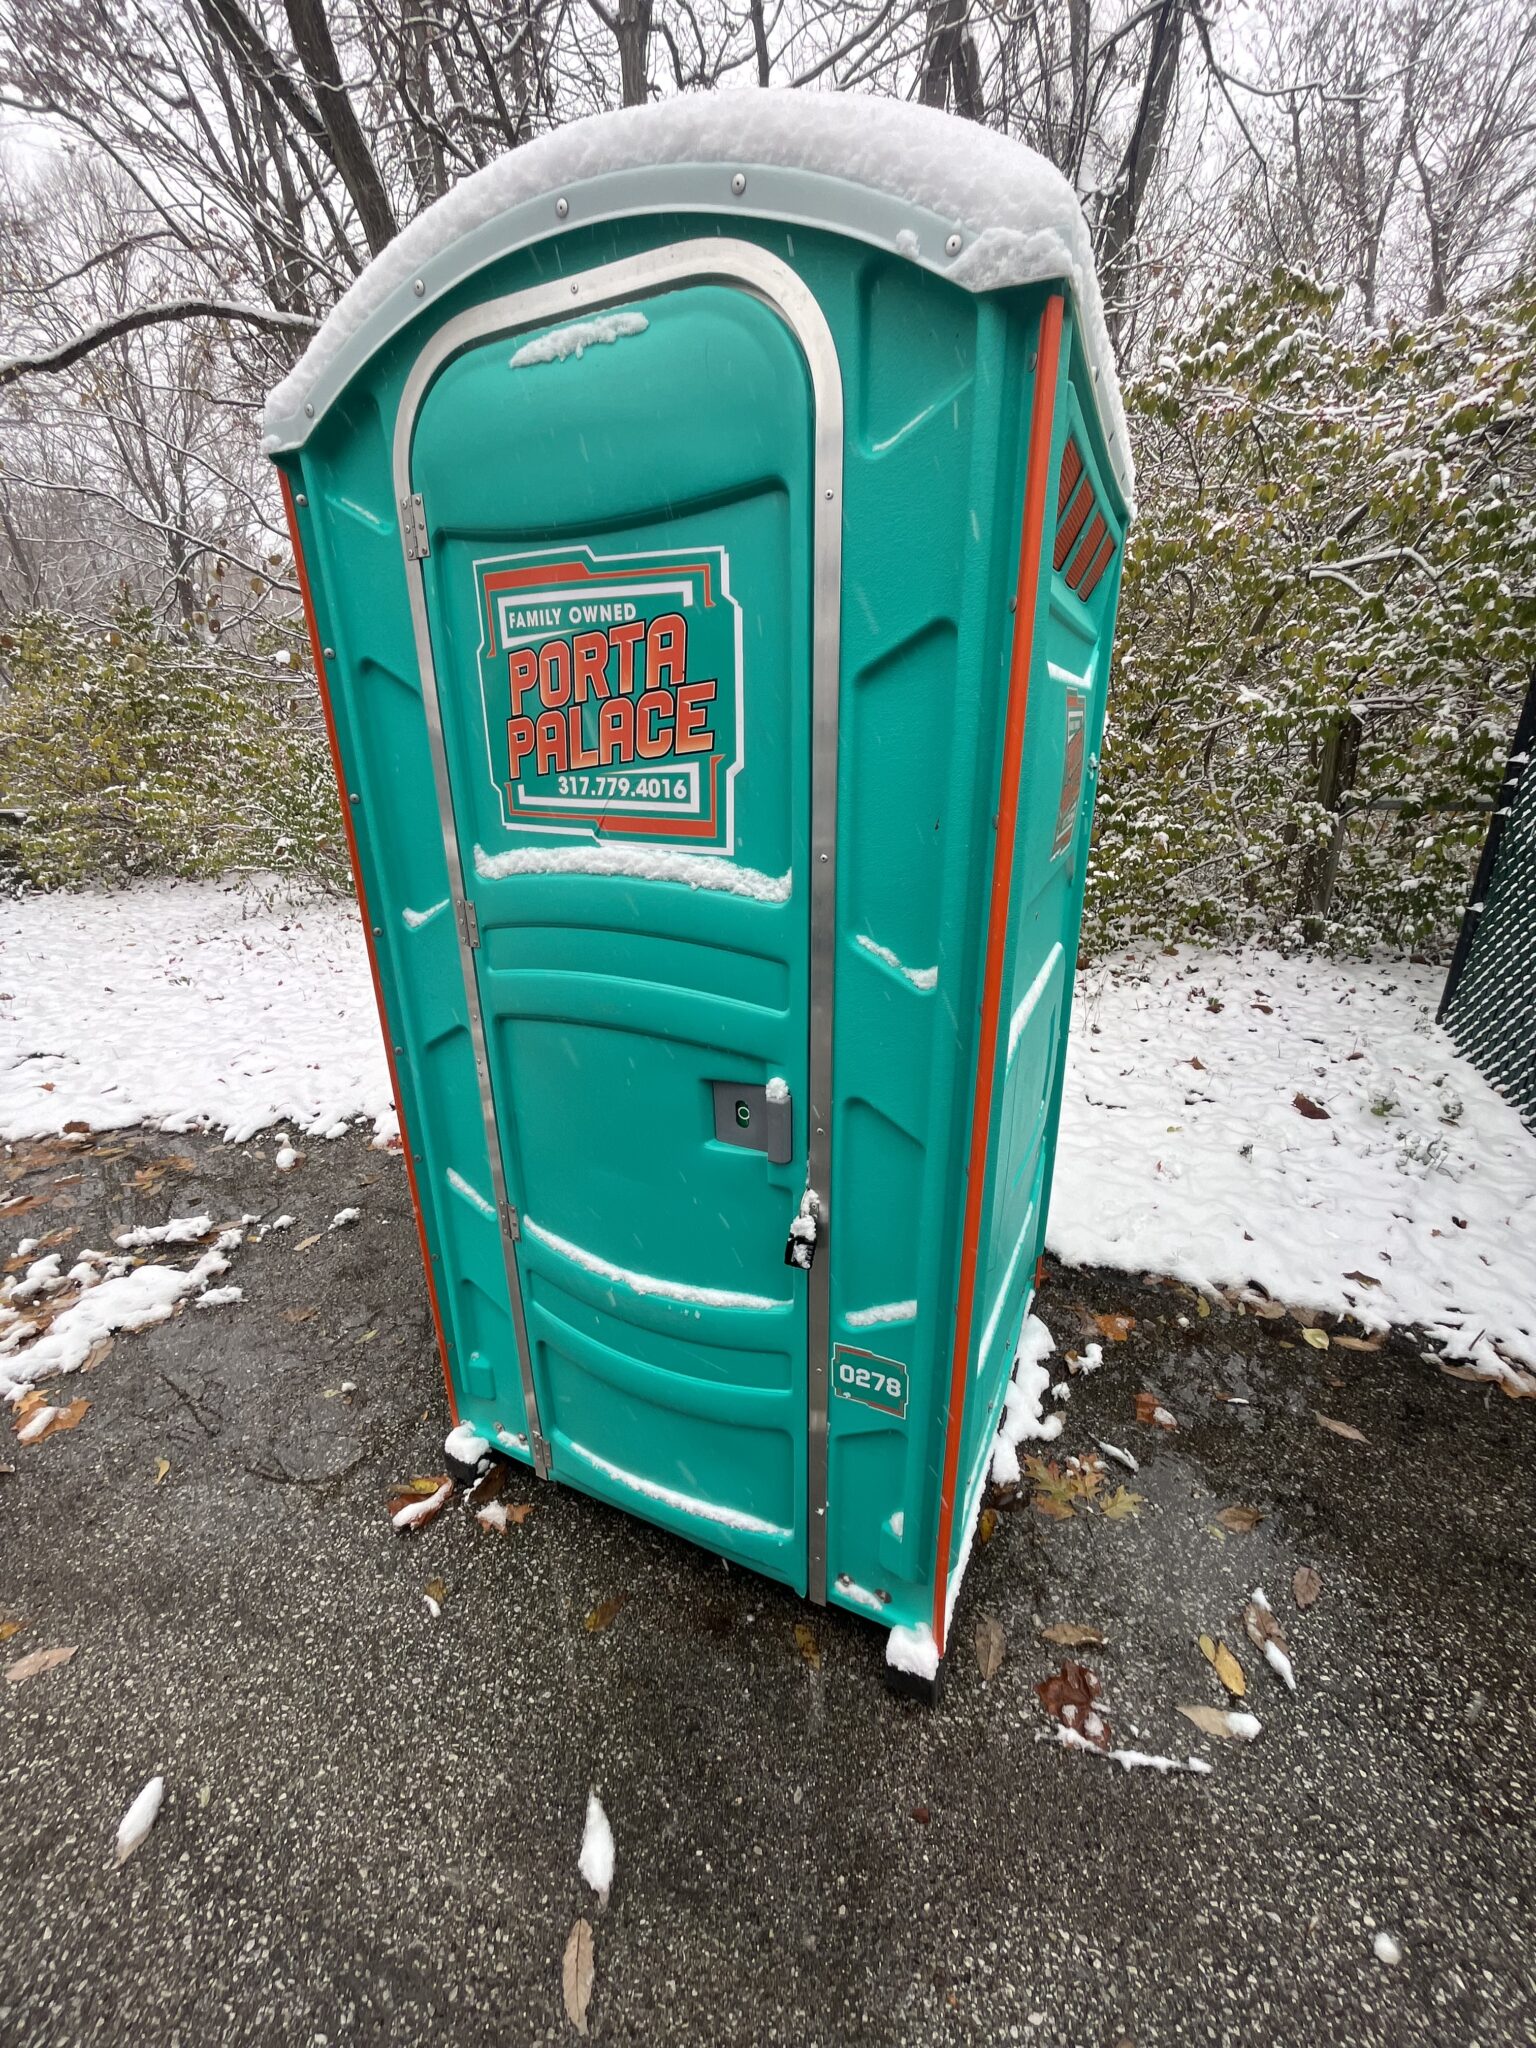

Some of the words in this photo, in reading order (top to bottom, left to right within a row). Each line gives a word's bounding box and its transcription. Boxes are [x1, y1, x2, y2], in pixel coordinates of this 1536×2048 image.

[509, 607, 561, 628] FAMILY
[569, 603, 636, 623] OWNED
[508, 613, 687, 716] PORTA
[507, 679, 717, 780] PALACE
[558, 775, 687, 799] 317.779.4016
[839, 1363, 902, 1398] 0278
